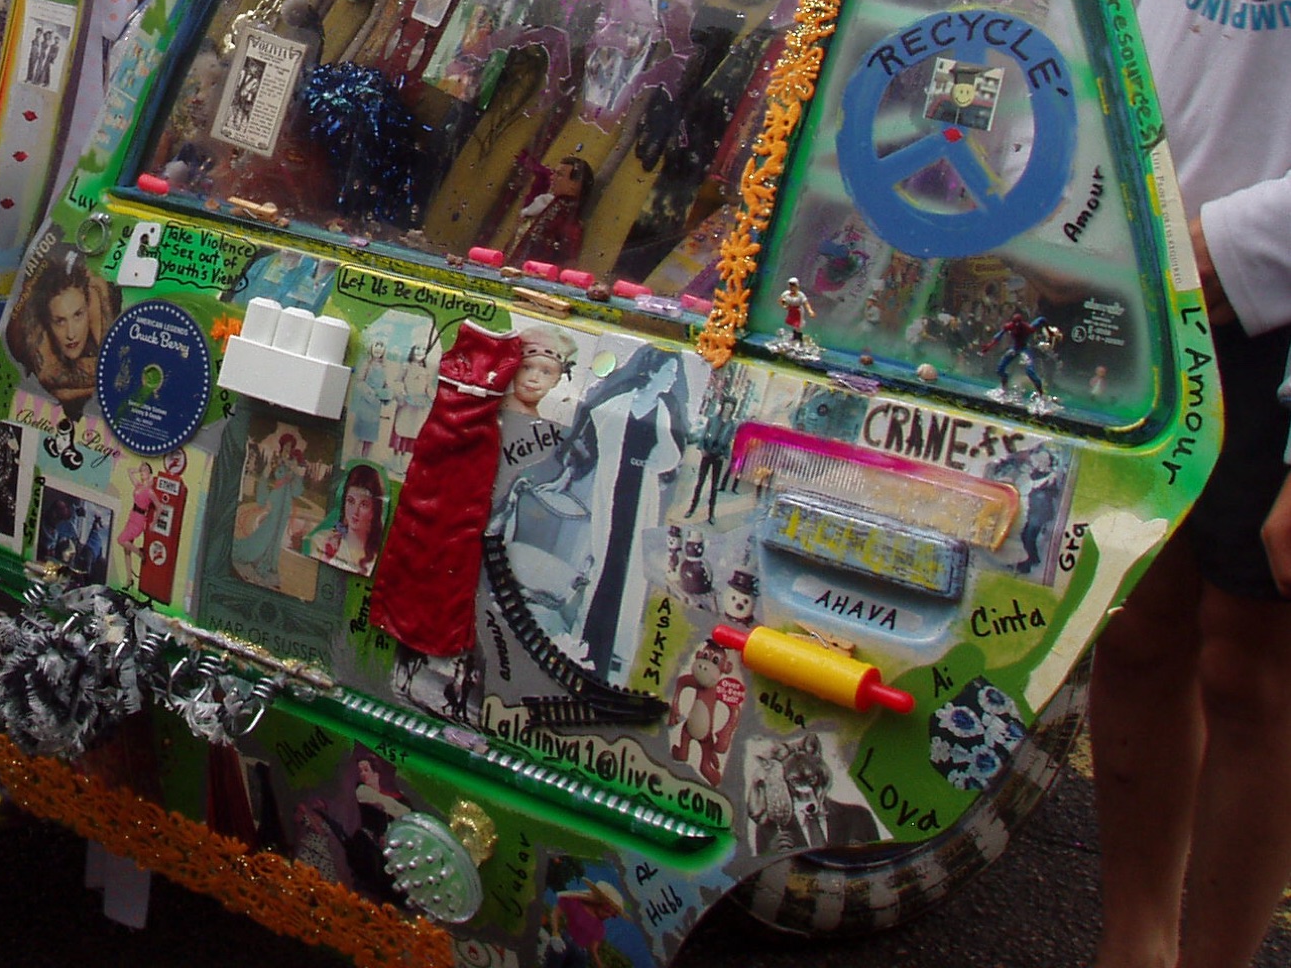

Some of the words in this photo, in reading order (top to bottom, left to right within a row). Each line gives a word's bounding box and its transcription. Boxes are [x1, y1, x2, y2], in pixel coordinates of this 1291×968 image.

[69, 176, 98, 212] Luv
[1063, 165, 1106, 244] Amour
[25, 232, 57, 278] TATTOO
[166, 224, 193, 245] Take
[200, 230, 255, 259] Violence
[171, 244, 193, 261] Sex
[199, 251, 220, 265] out
[223, 257, 238, 269] of
[340, 268, 366, 289] Let
[371, 274, 388, 297] Us
[394, 282, 410, 300] Be
[130, 322, 159, 346] Chuck
[159, 331, 190, 359] Berry
[136, 315, 163, 331] AMERICAN
[163, 322, 189, 337] LEGENDS
[15, 408, 55, 433] Bettie
[81, 428, 122, 469] Page
[502, 422, 566, 467] Kärlek
[815, 589, 898, 631] AHAVA
[930, 666, 955, 698] Ai
[759, 691, 807, 730] aloha
